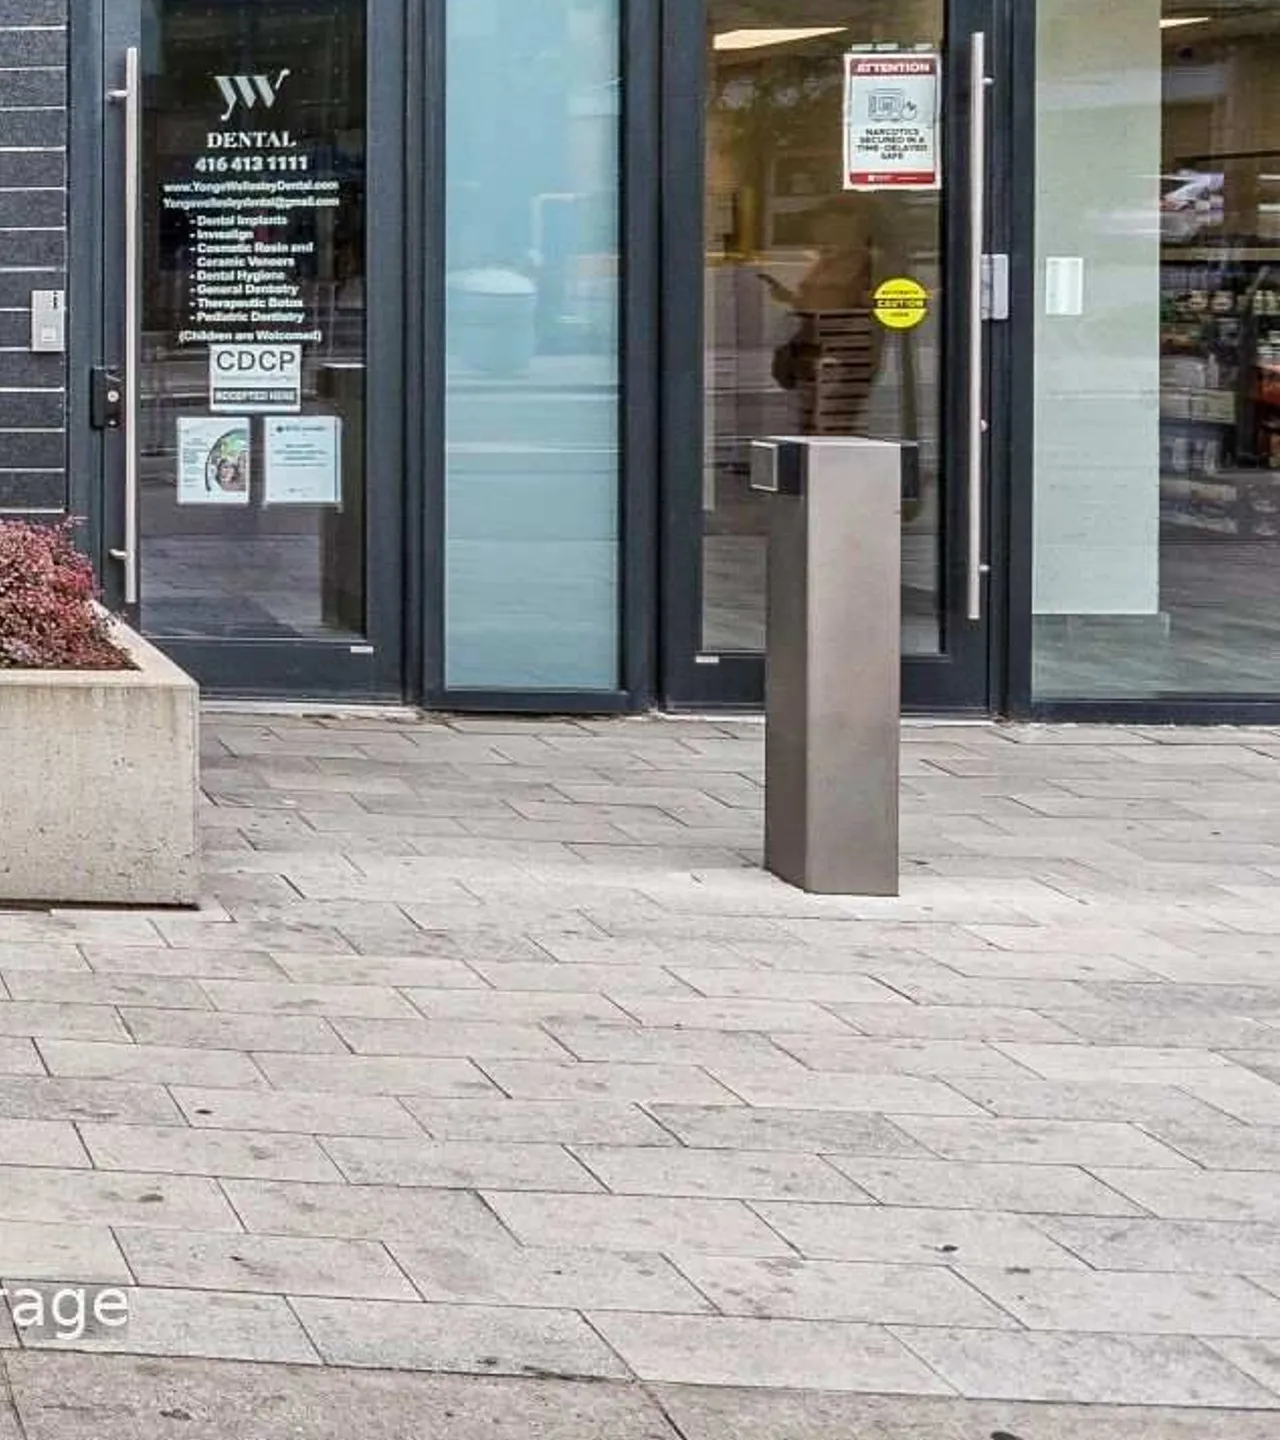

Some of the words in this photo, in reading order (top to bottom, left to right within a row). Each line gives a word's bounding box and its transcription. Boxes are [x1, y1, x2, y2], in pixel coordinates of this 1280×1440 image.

[857, 64, 930, 72] ATTENTION
[206, 131, 297, 148] DENTAL
[194, 157, 228, 172] 416
[230, 156, 263, 171] 413
[267, 155, 308, 170] 1111
[197, 215, 234, 226] Dental
[291, 242, 314, 253] and
[197, 270, 234, 281] Dental
[197, 284, 242, 295] General
[217, 350, 295, 372] CDCP
